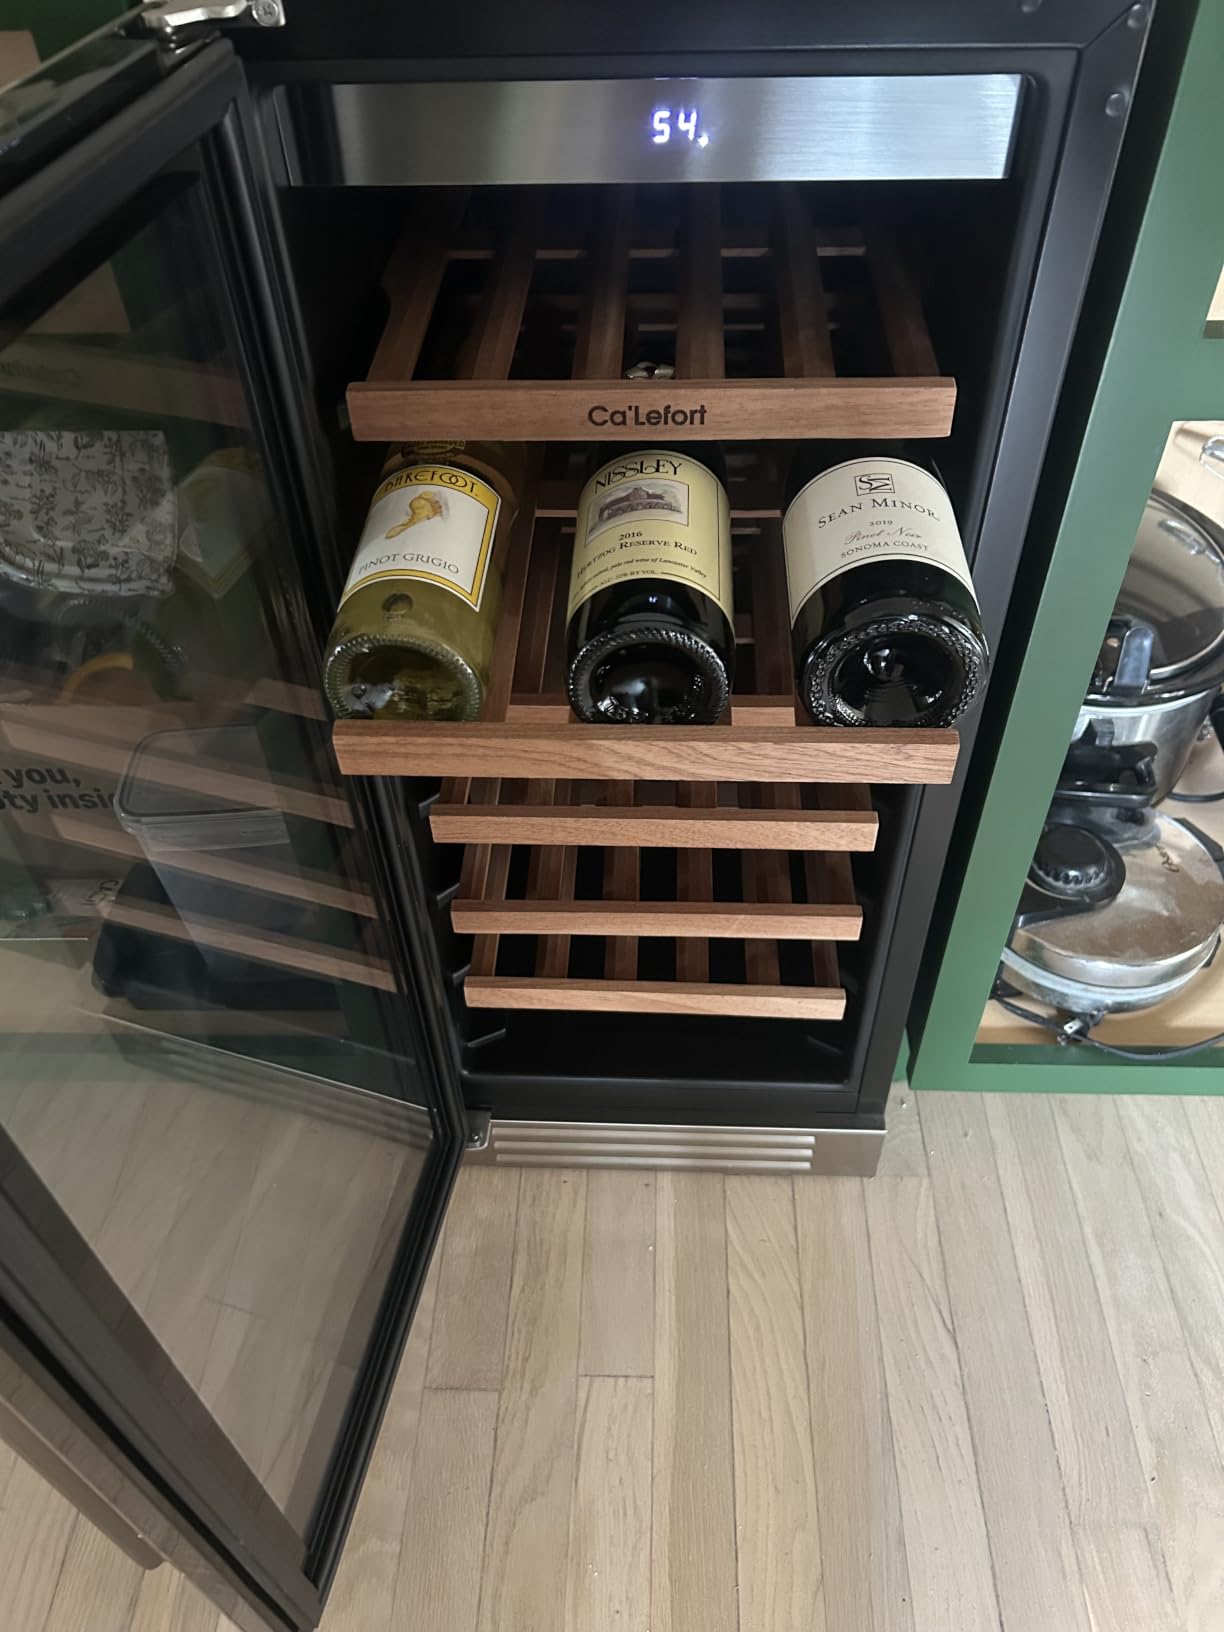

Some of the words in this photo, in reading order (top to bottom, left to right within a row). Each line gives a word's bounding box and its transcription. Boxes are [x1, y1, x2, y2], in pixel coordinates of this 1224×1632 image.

[587, 404, 707, 427] Ca'Lefort
[384, 470, 478, 493] BAREFOOT
[594, 458, 683, 494] NISSLEY
[817, 502, 864, 529] SEAN
[871, 497, 940, 522] MINOR
[619, 530, 643, 541] 2016
[843, 529, 885, 546] Pinot
[886, 526, 923, 540] Noir
[619, 540, 671, 550] RESERVE
[673, 540, 698, 555] RED
[840, 540, 890, 559] SONOMA
[893, 540, 929, 551] COAST
[358, 552, 400, 575] PINOT
[402, 551, 460, 575] GRIGIO
[2, 768, 81, 788] you,
